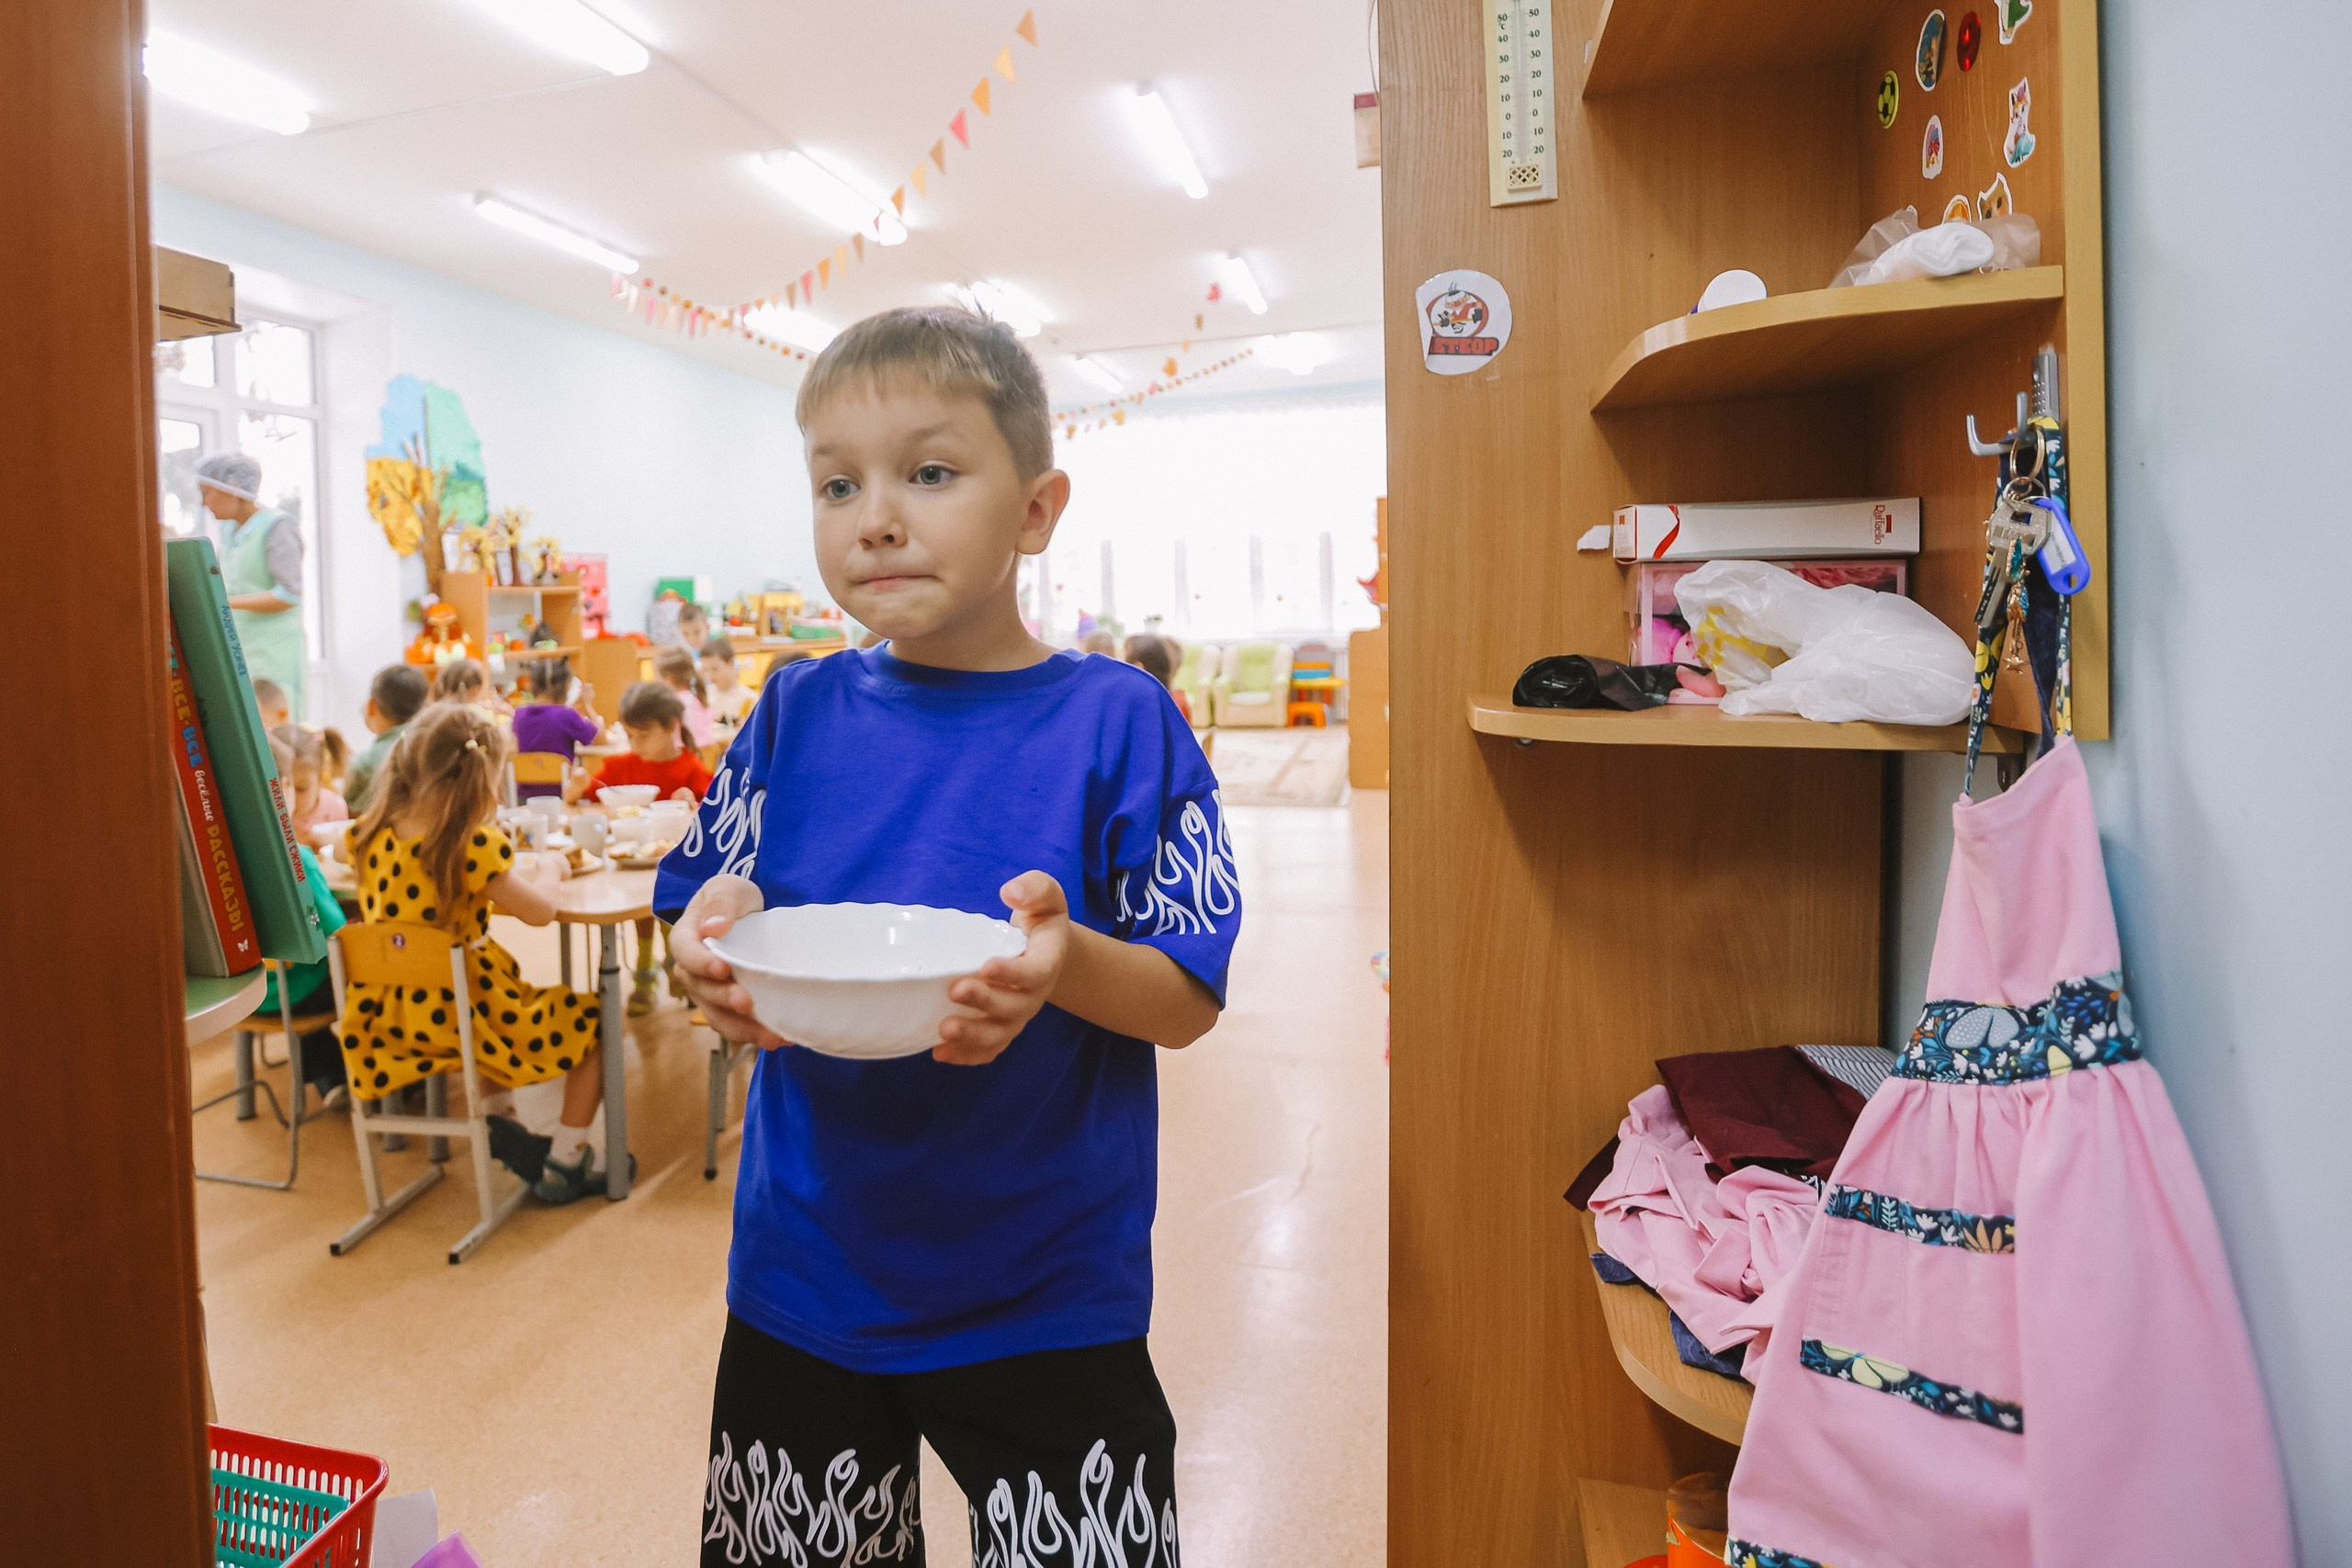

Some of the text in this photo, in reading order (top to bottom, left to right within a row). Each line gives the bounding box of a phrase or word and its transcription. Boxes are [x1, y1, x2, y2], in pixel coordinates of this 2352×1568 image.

[1529, 8, 1539, 17] 50
[1498, 14, 1508, 22] 50
[1529, 29, 1540, 38] 40
[1531, 50, 1541, 59] 30
[1499, 55, 1510, 63] 30
[1532, 70, 1542, 78] 20
[1499, 74, 1510, 83] 20
[1532, 89, 1543, 97] 10
[1501, 94, 1510, 102] 10
[1534, 127, 1544, 135] 10
[1502, 131, 1511, 140] 10
[1533, 145, 1544, 153] 20
[1502, 150, 1512, 158] 20
[1873, 505, 1885, 545] Raffaello
[269, 778, 306, 882] ЖИЛИ БЫЛИ ЕЖИКИ
[195, 770, 214, 821] весёлые
[207, 824, 244, 931] РАССКАЗЫ
